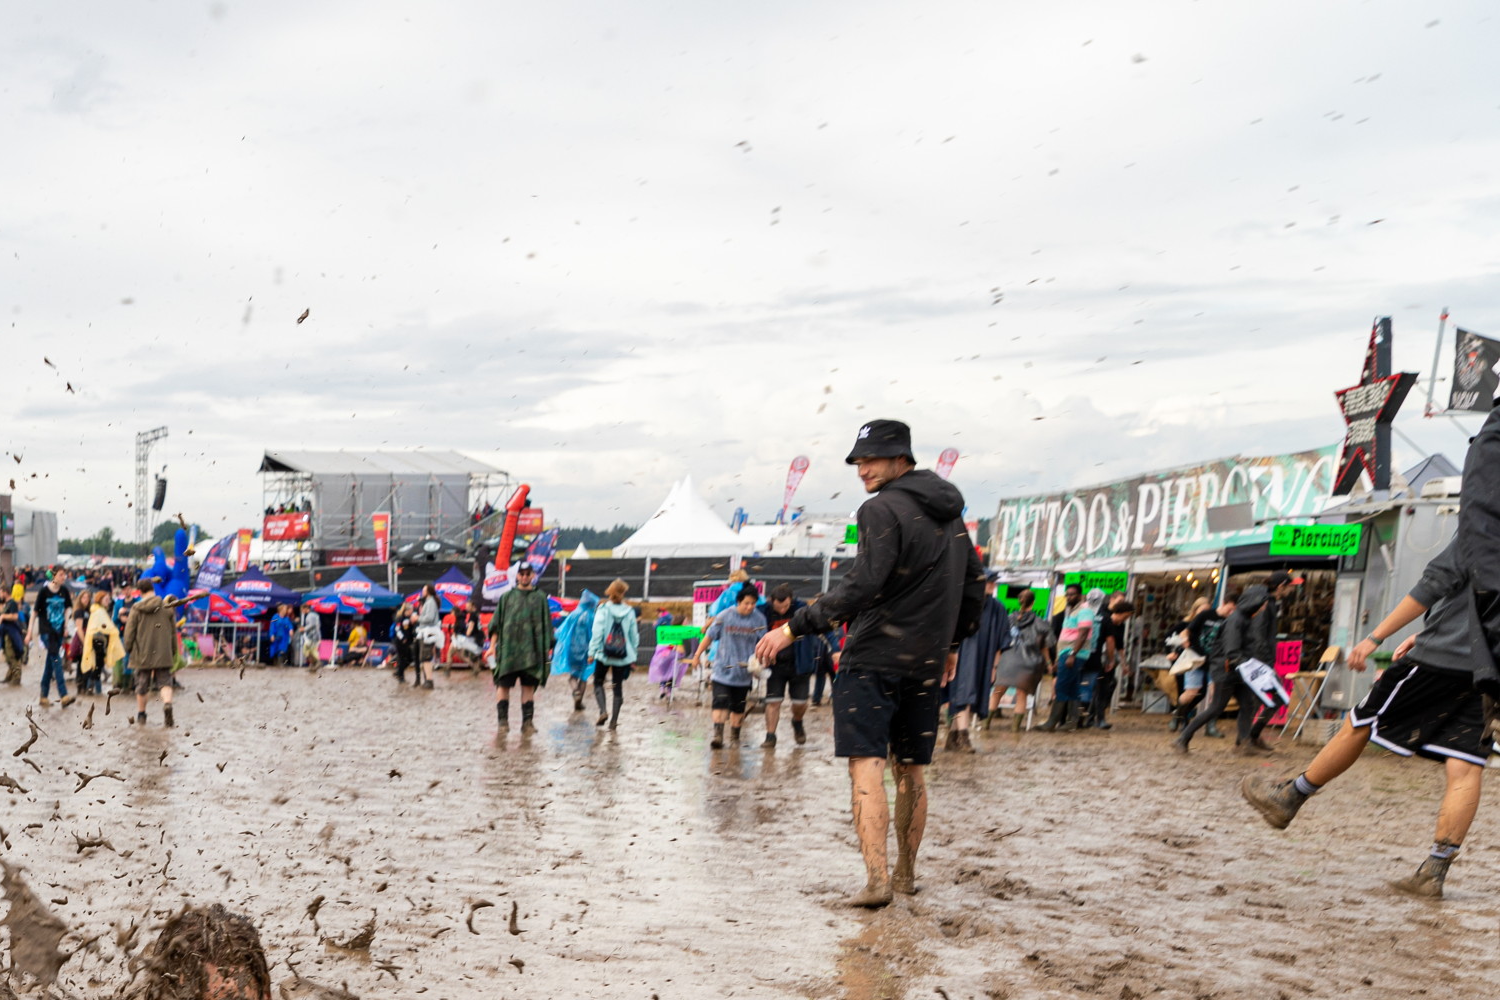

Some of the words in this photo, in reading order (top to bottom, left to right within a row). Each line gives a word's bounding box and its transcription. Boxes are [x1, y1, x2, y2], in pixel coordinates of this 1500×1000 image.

[998, 492, 1112, 562] TATTOO
[1113, 501, 1135, 551] &
[1290, 527, 1357, 552] Piercings
[1080, 573, 1125, 590] Piercings
